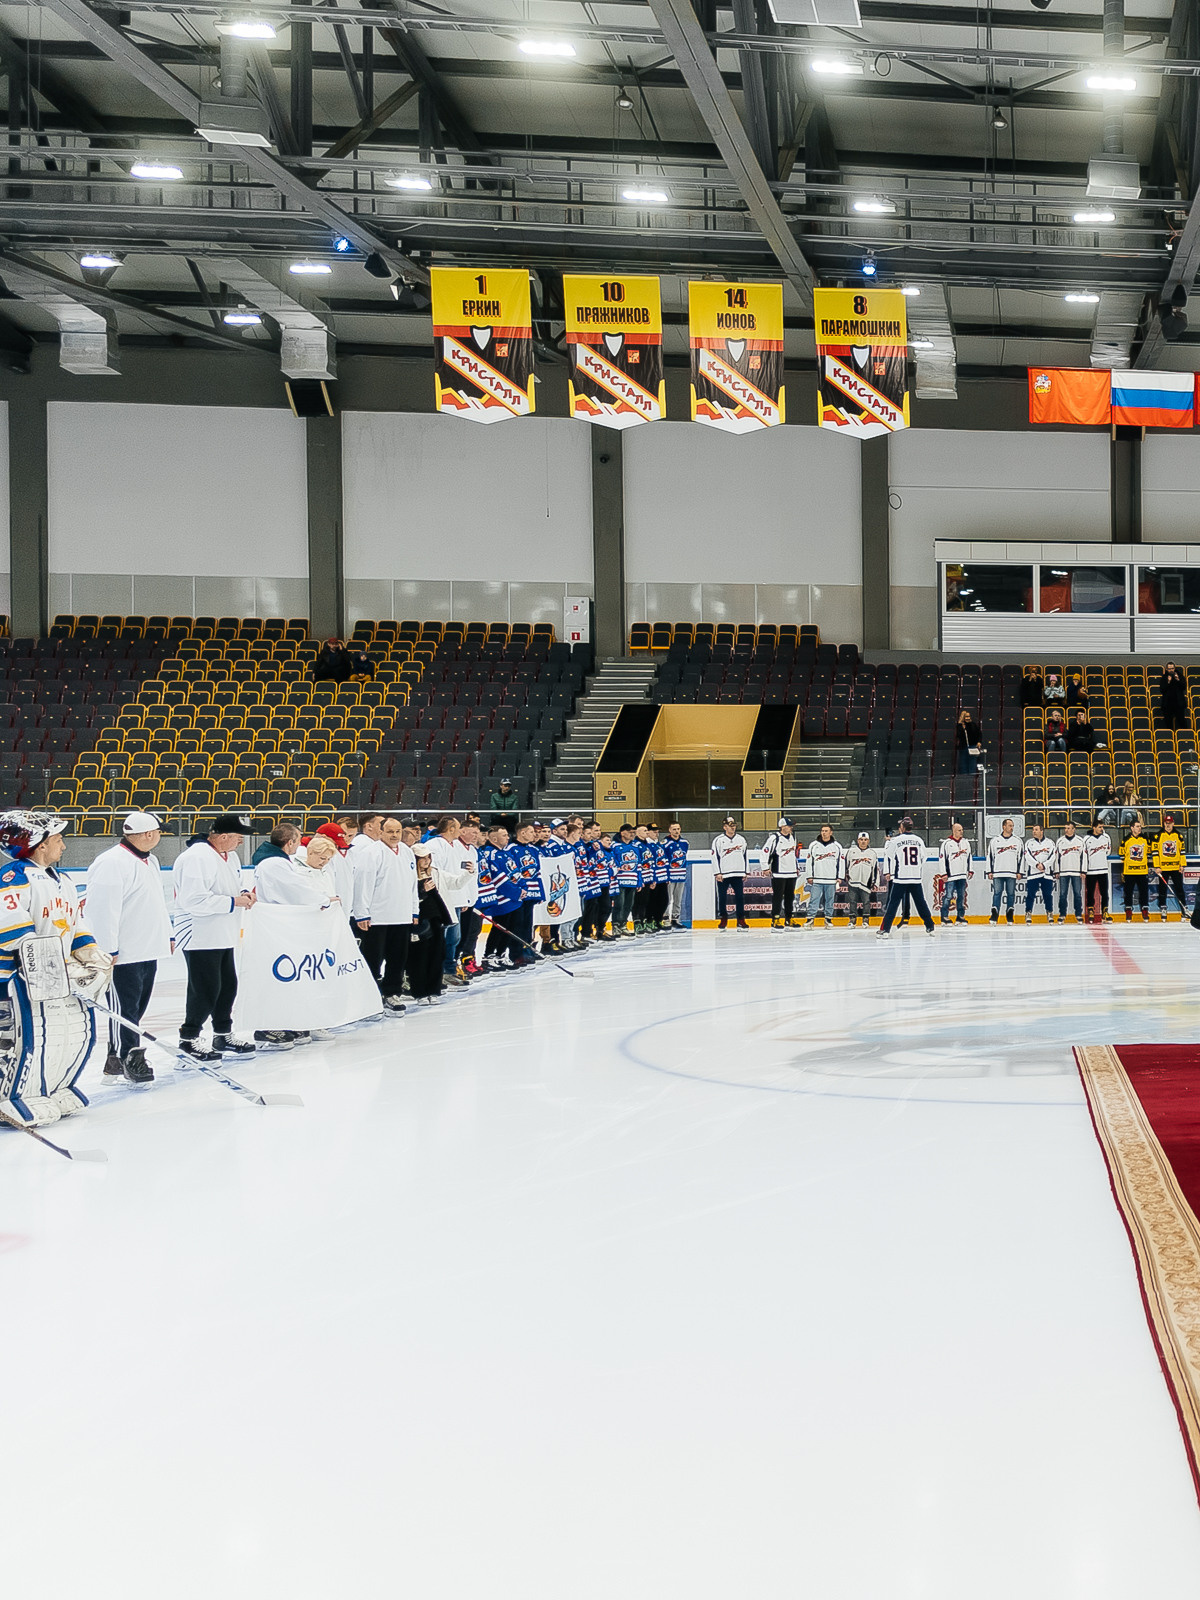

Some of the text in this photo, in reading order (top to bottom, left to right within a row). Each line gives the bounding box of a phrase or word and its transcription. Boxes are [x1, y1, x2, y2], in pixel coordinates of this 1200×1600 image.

[475, 275, 486, 295] 1
[600, 281, 625, 303] 10
[462, 299, 502, 318] ЕРКИН
[724, 288, 749, 309] 14
[853, 295, 867, 316] 8
[576, 306, 651, 324] ПРЯЖНИКОВ
[716, 312, 757, 331] ИОНОВ
[821, 319, 902, 338] ПАРАМОШКИН
[451, 348, 522, 405] КРИСТАЛЛ
[584, 355, 653, 412] КРИСТАЛЛ
[706, 361, 773, 417] КРИСТАЛЛ
[832, 367, 898, 422] КРИСТАЛЛ
[902, 846, 919, 866] 18
[16, 1052, 33, 1096] CCM
